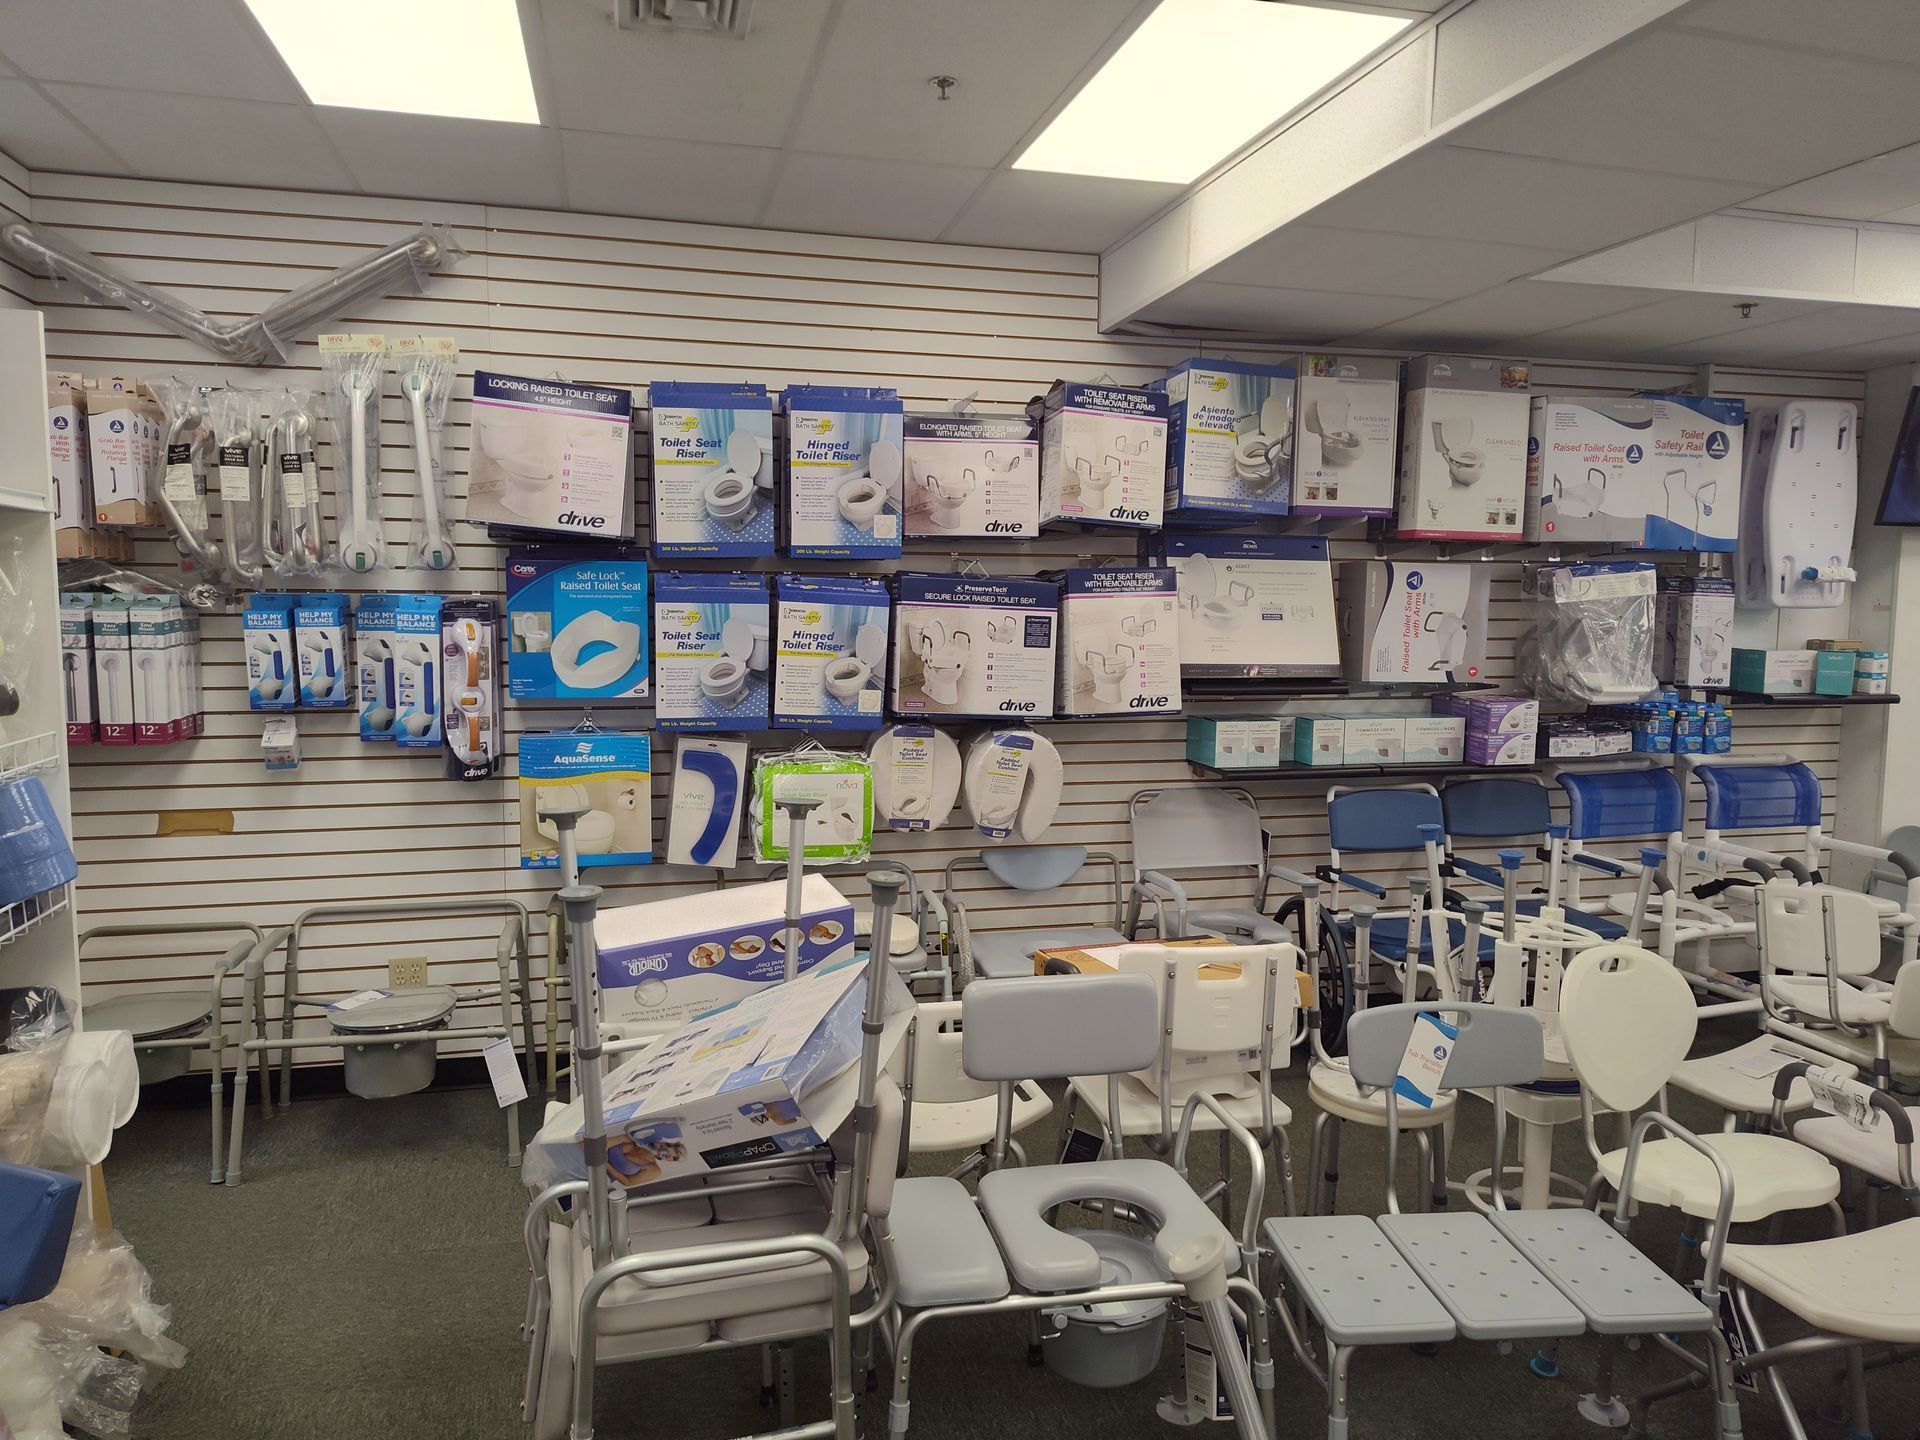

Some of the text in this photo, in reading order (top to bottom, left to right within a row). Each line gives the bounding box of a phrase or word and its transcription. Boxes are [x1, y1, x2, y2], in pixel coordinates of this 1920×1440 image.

[1340, 370, 1359, 378] BEMIS
[1433, 369, 1452, 378] BEMIS
[488, 378, 618, 403] LOCKING RAISED TOILET SEAT
[1083, 388, 1148, 404] TOILET SEAT RISER
[548, 397, 572, 406] HEIGHT
[1074, 395, 1156, 412] WITH REMOVABLE ARMS
[1200, 405, 1235, 416] Asiento
[1206, 414, 1243, 424] inodoro
[919, 423, 958, 432] ELONGATED
[959, 424, 983, 432] RAISED
[1198, 420, 1235, 432] elevado
[1680, 429, 1705, 439] Toilet
[660, 437, 723, 448] Toilet Seat
[807, 440, 849, 452] Hinged
[1553, 443, 1626, 453] Raised Toilet Seat
[1655, 440, 1704, 453] Safety Rail
[101, 449, 128, 457] Rotating
[676, 449, 707, 459] Riser
[796, 450, 862, 461] Toilet Riser
[107, 456, 129, 464] Flange
[1583, 454, 1625, 464] with Arms
[557, 510, 606, 528] drive
[1109, 505, 1150, 522] drive
[985, 519, 1023, 533] drive
[513, 564, 537, 574] Carex
[1092, 573, 1117, 581] TOILET
[1134, 572, 1155, 580] RISER
[560, 581, 641, 592] Raised Toilet Seat
[1084, 581, 1102, 589] WITH
[1102, 580, 1144, 588] REMOVABLE
[924, 592, 953, 602] SECURE
[952, 594, 972, 602] LOCK
[971, 594, 996, 603] RAISED
[996, 596, 1020, 604] TOILET
[357, 611, 379, 619] HELP
[1412, 592, 1423, 639] with Arms
[358, 617, 396, 625] BALANCE
[397, 620, 436, 628] BALANCE
[661, 632, 721, 641] Toilet Seat
[792, 630, 835, 642] Hinged
[1401, 591, 1413, 673] Raised Toilet Seat
[677, 641, 707, 651] Riser
[782, 640, 845, 652] Toilet Riser
[1702, 676, 1724, 686] drive
[998, 698, 1037, 713] drive
[1129, 694, 1169, 710] drive
[553, 753, 617, 765] AquaSense
[1000, 756, 1021, 765] Padded
[464, 768, 488, 778] drive
[836, 778, 858, 790] nova
[683, 792, 705, 801] vive
[628, 957, 669, 976] CONTOUR
[755, 959, 784, 970] And Day!
[1477, 969, 1486, 999] drive
[1407, 1047, 1443, 1069] Tub Transfer
[1422, 1063, 1442, 1077] Bench
[743, 1141, 777, 1156] CPAP
